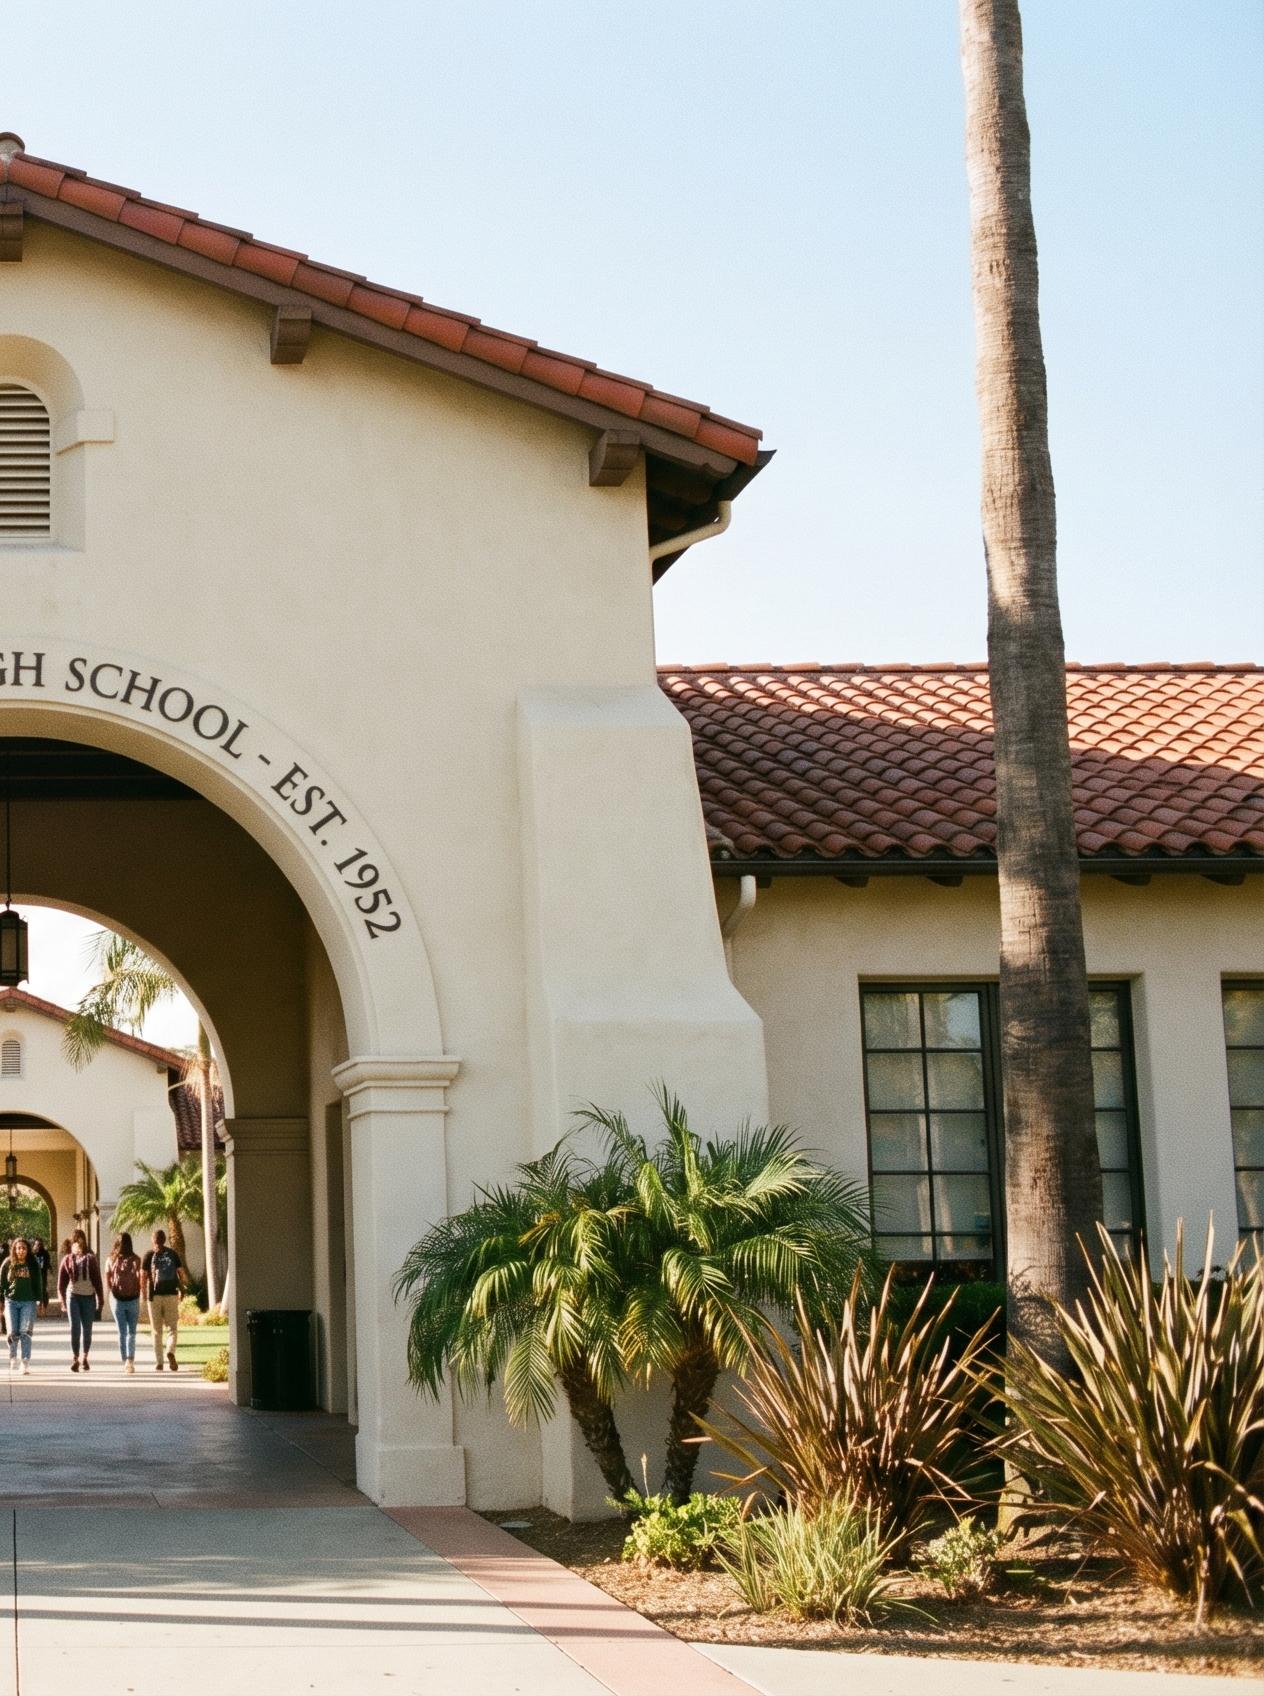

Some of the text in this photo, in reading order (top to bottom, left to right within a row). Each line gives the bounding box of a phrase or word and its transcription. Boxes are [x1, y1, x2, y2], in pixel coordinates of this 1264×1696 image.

[64, 657, 250, 760] SCHOOL
[271, 762, 348, 847] EST.
[333, 847, 403, 940] 1952
